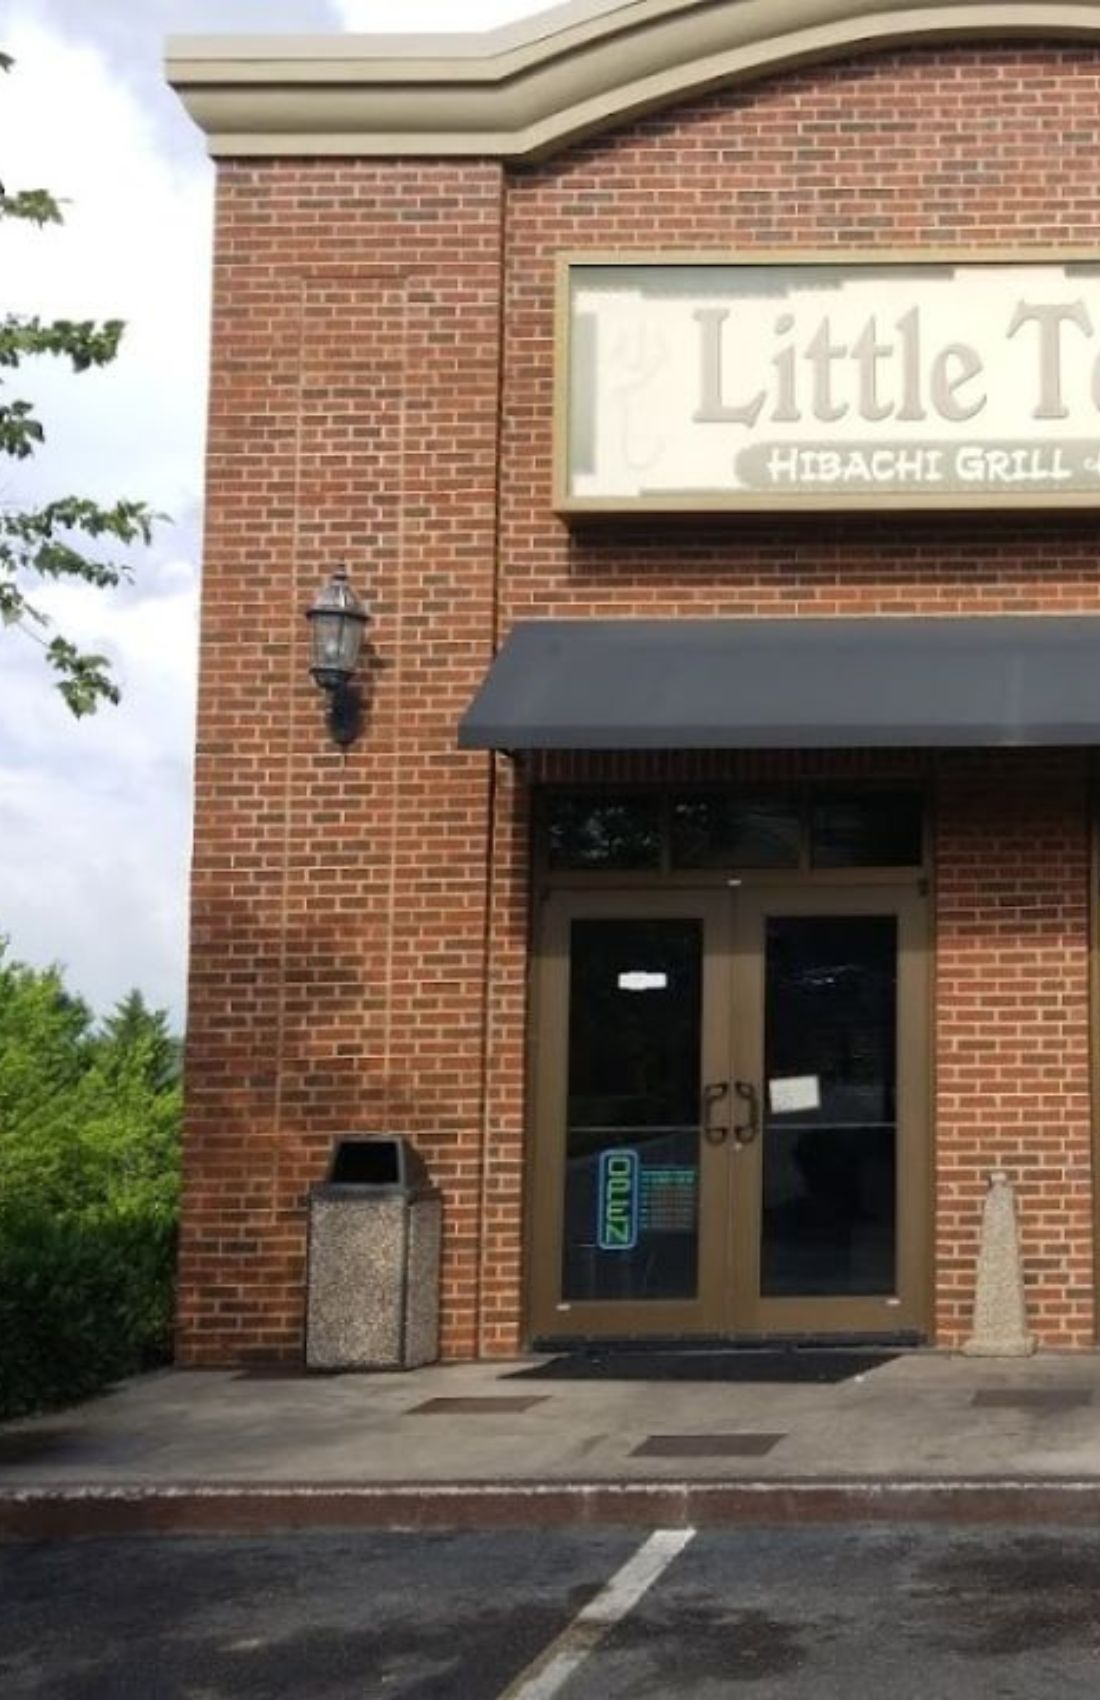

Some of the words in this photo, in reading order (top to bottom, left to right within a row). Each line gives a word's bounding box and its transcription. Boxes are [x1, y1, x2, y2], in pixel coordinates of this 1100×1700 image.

[690, 305, 988, 429] Little
[766, 447, 944, 483] HIBACHI
[955, 445, 1073, 482] GRILL
[606, 1156, 631, 1243] OPEN
